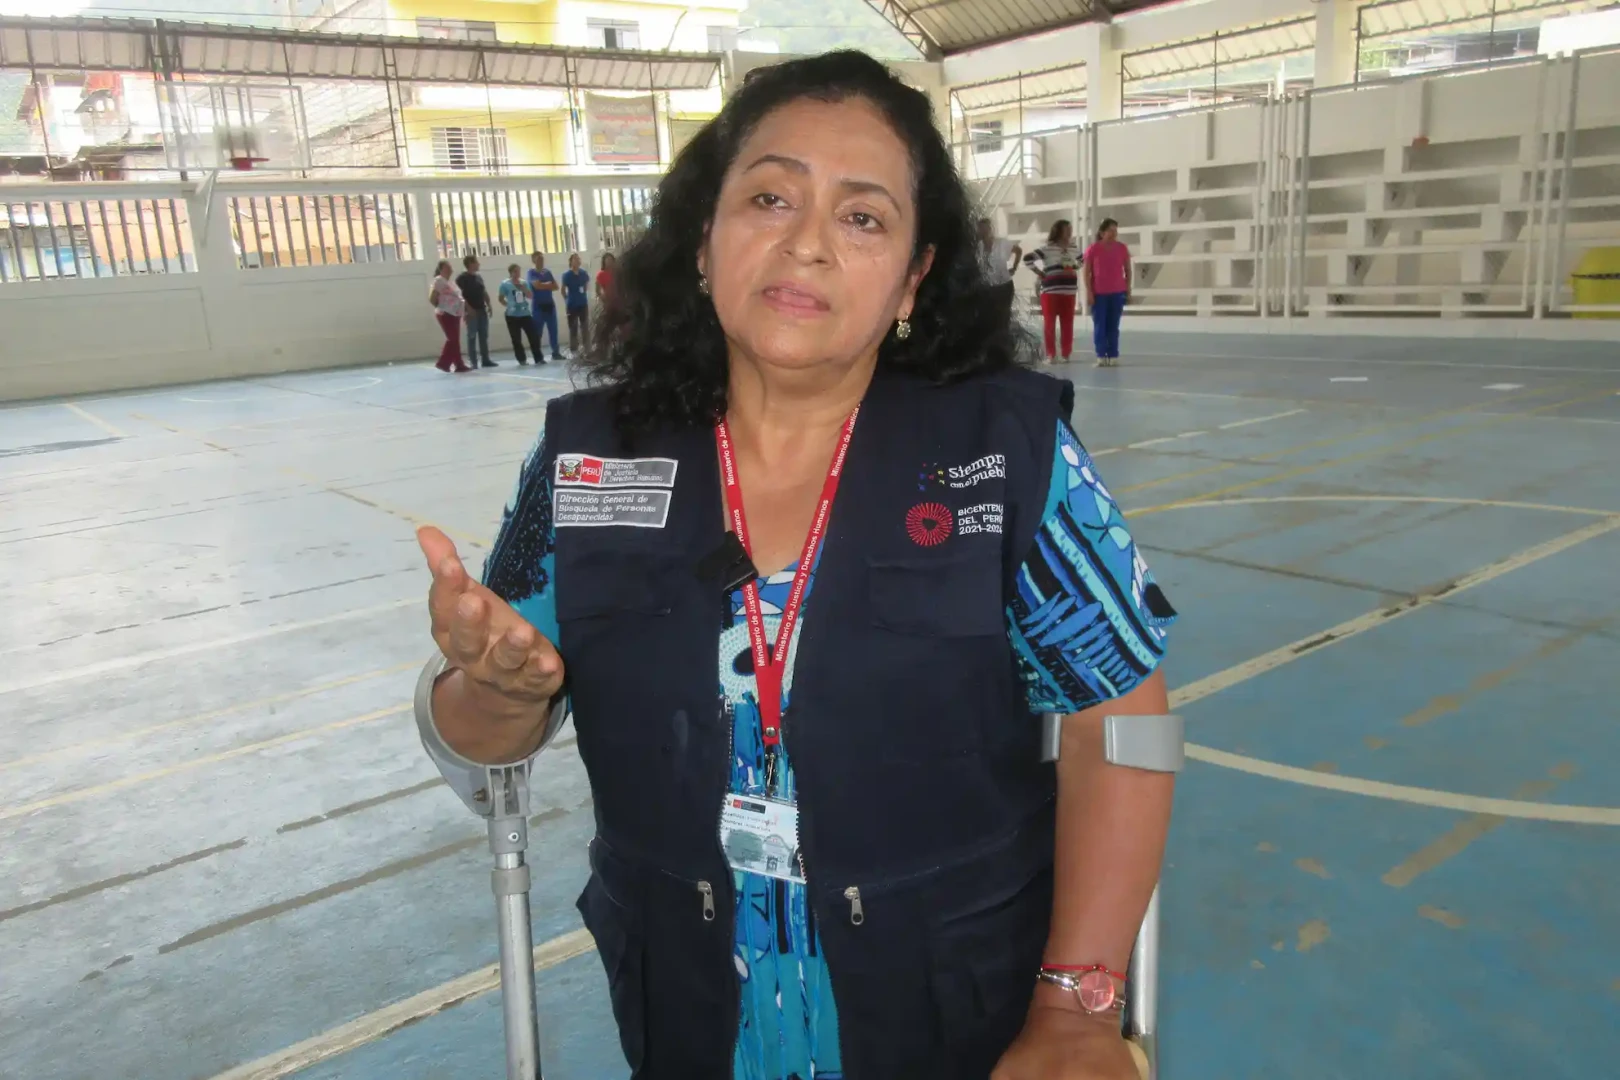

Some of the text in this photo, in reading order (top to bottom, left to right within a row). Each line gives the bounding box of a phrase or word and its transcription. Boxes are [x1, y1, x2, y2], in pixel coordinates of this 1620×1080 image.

[721, 439, 729, 449] de
[831, 444, 848, 477] Ministerio
[725, 450, 735, 486] Ministerio
[559, 494, 649, 504] Dirección General de
[558, 503, 656, 514] Búsqueda de Personas
[557, 512, 614, 523] Desaparecidas
[958, 516, 978, 526] DEL
[775, 499, 829, 662] Ministerio de Justicia y Derechos Humanos
[746, 583, 766, 667] Ministerio de Justicia
